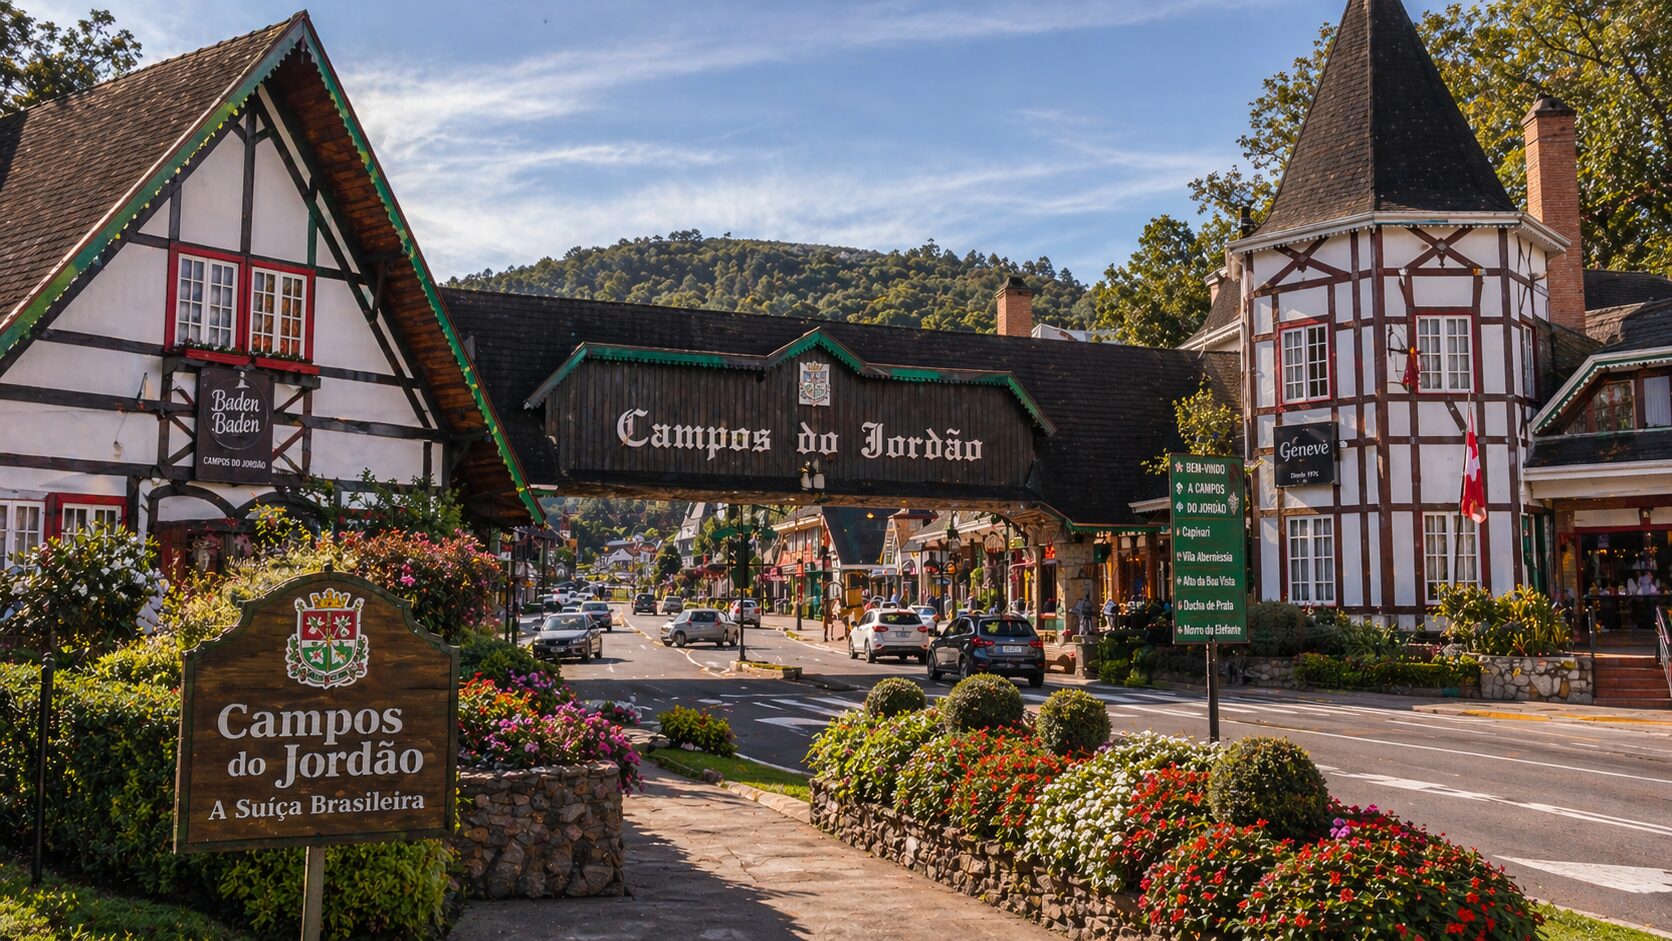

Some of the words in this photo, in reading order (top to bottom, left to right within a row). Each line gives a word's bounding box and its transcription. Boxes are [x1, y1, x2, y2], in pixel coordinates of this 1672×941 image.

[211, 389, 260, 412] Baden
[211, 412, 260, 434] Baden
[616, 408, 772, 461] Campos
[797, 422, 839, 455] do
[860, 421, 983, 462] Jordão
[203, 456, 230, 467] CAMPOS
[231, 459, 240, 467] DO
[1186, 462, 1225, 474] BEM-VINDO
[1187, 483, 1193, 493] A
[1195, 483, 1225, 494] CAMPOS
[1187, 503, 1198, 513] DO
[1182, 525, 1210, 539] Capivari
[1182, 551, 1195, 561] Vila
[1183, 576, 1196, 586] Alto
[1206, 575, 1219, 586] Boa
[1219, 575, 1235, 586] Vista
[1183, 600, 1205, 610] Ducha
[1206, 600, 1215, 610] de
[1184, 624, 1204, 635] Morro
[1205, 625, 1213, 635] do
[1215, 624, 1241, 635] Elefante
[217, 703, 403, 746] Campos
[227, 751, 266, 777] do
[275, 740, 424, 788] Jordão
[208, 800, 227, 820] A
[235, 796, 303, 821] Suíça
[310, 791, 425, 815] Brasileira
